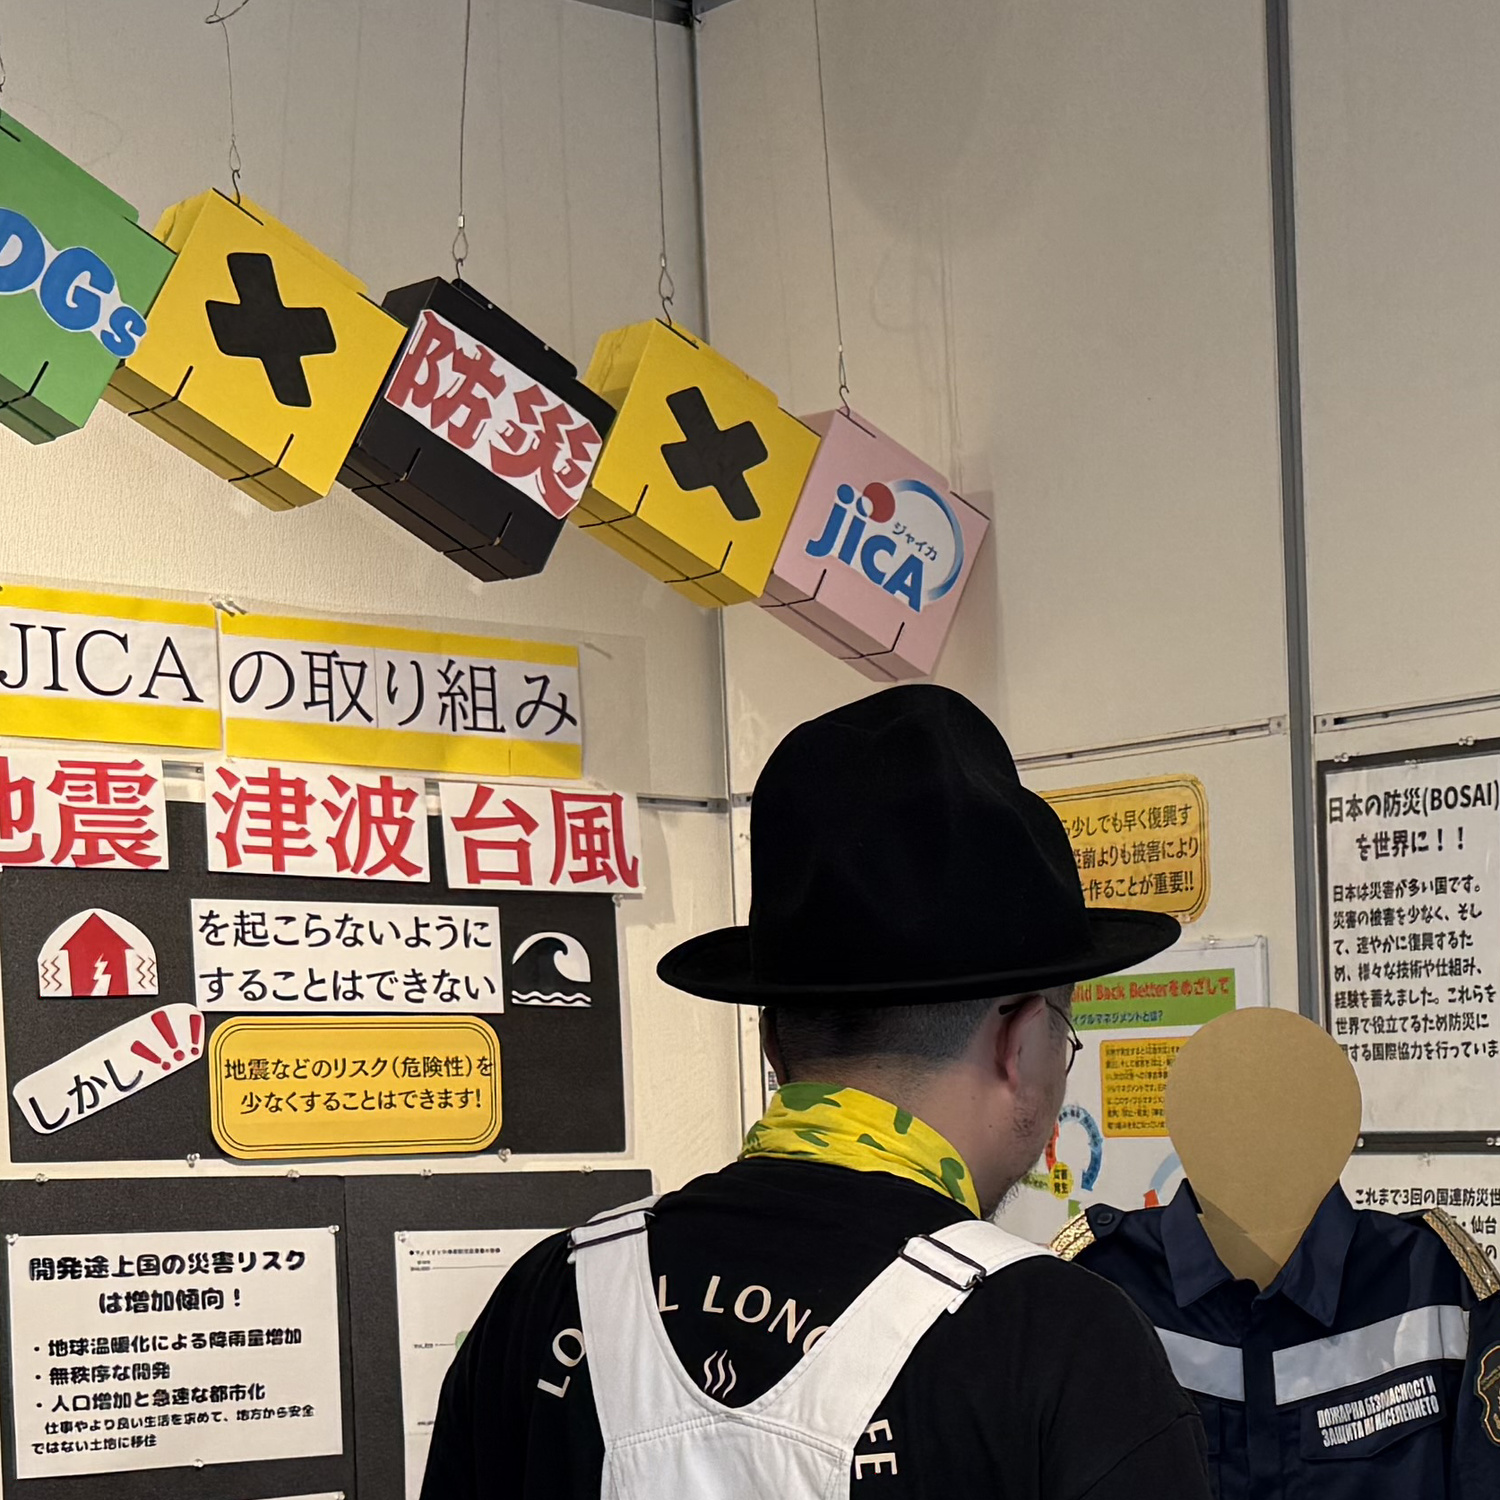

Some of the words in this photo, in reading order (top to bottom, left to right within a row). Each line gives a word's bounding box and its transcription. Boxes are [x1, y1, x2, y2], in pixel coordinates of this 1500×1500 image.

[386, 310, 602, 517] 防災
[0, 623, 578, 735] JICAの取り組み
[212, 767, 424, 879] 津波
[451, 783, 640, 889] 台風
[198, 910, 493, 950] を起こらないように
[201, 967, 497, 1004] することはできない
[29, 1250, 306, 1281] 開発途上国の災害リスク
